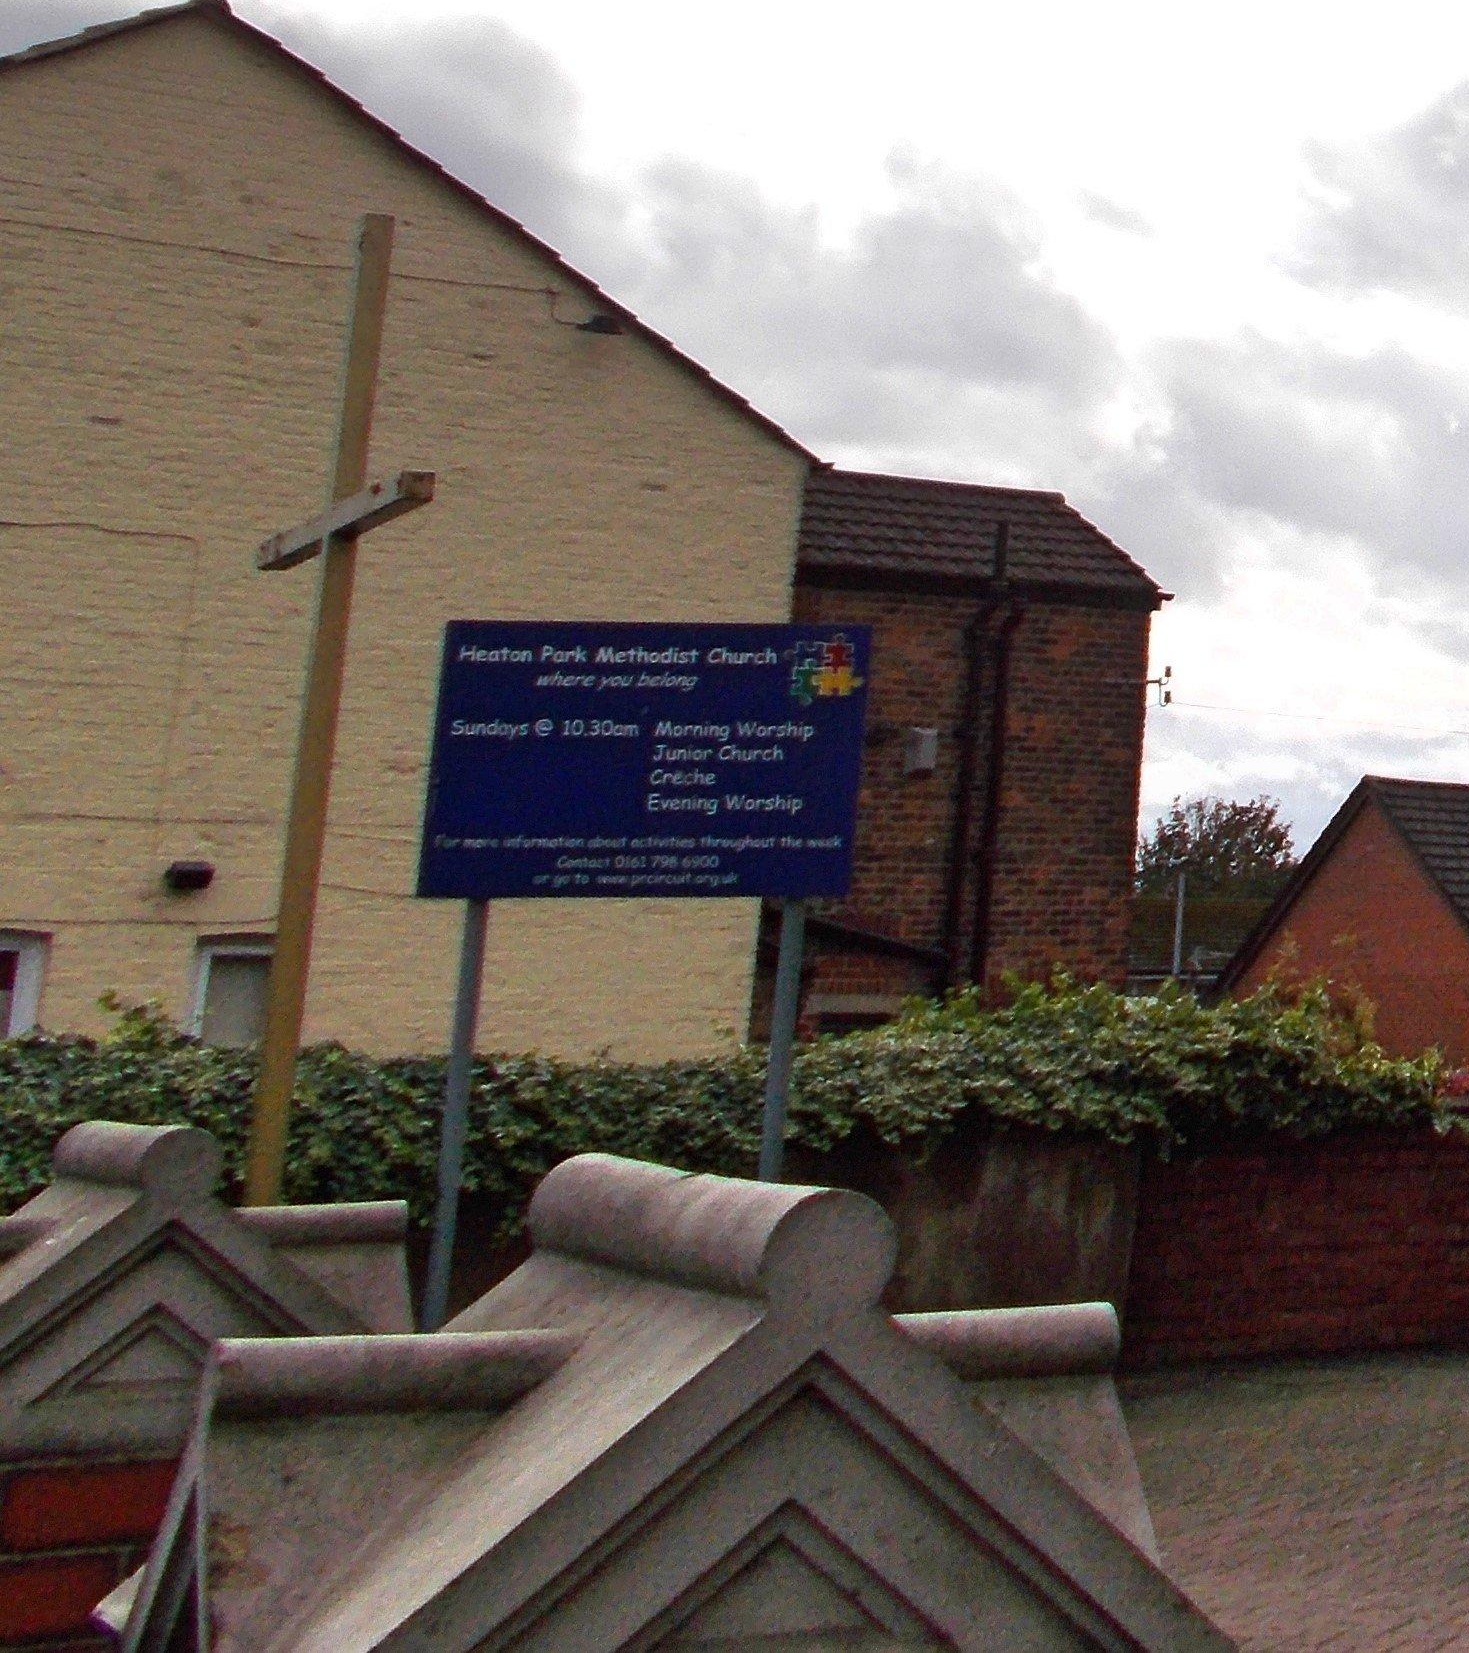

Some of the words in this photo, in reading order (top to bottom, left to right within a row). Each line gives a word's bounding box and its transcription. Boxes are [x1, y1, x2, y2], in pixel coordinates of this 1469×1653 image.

[459, 646, 533, 663] Heaton
[540, 645, 587, 664] Park
[595, 646, 699, 665] Methodist
[706, 648, 777, 665] Church
[536, 671, 596, 687] where
[597, 674, 634, 691] you
[638, 672, 699, 692] belong
[451, 719, 528, 738] Sundays
[535, 718, 554, 737] @
[562, 718, 640, 738] 10.30am
[655, 721, 730, 742] Morning
[737, 721, 815, 742] Worship
[653, 744, 713, 762] Junior
[718, 744, 784, 762] Church
[648, 793, 719, 815] Evening
[725, 795, 803, 816] Worship
[503, 835, 584, 848] information
[587, 836, 627, 848] about
[630, 836, 696, 848] activities
[700, 835, 776, 852] throughout
[780, 836, 802, 848] the
[807, 836, 842, 848] week
[557, 855, 611, 869] Contact
[615, 855, 647, 869] 0161
